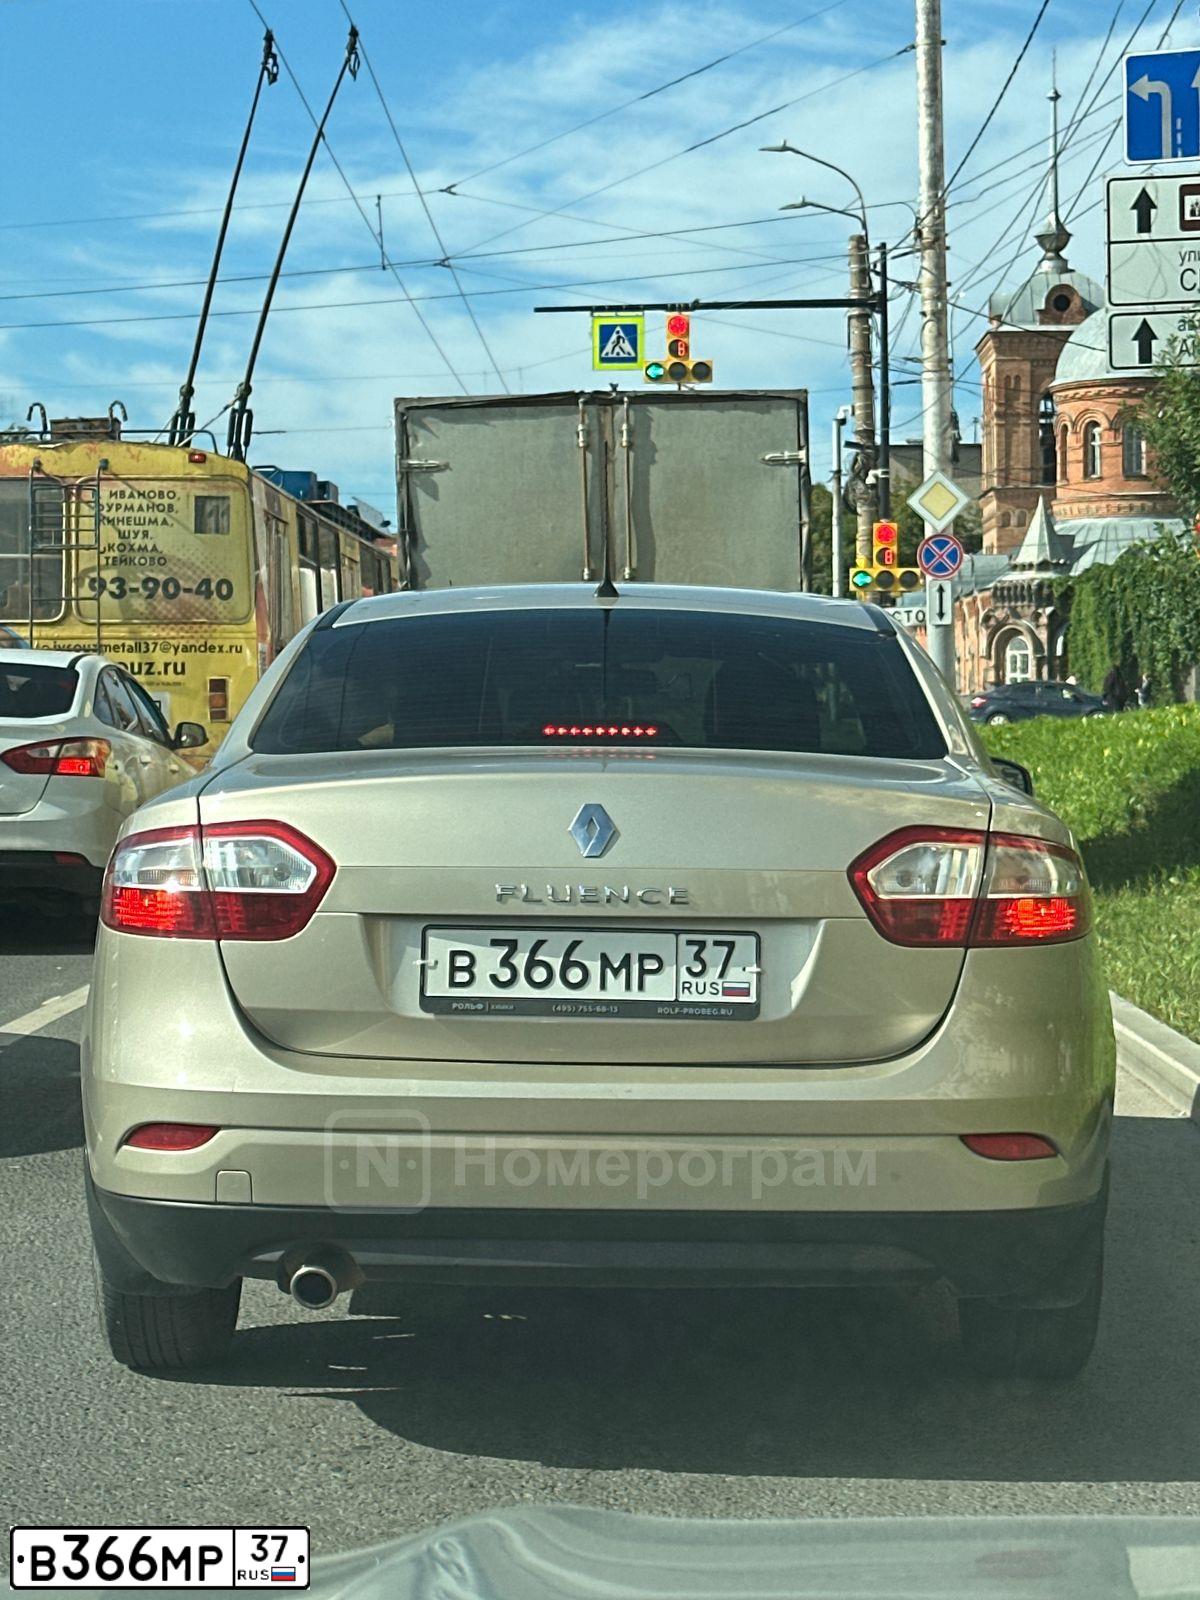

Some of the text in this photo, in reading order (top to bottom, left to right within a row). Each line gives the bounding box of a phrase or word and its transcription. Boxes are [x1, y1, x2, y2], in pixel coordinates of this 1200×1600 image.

[1180, 267, 1200, 293] С
[104, 556, 167, 567] ТЕЙКОВО
[88, 576, 234, 601] 93-90-40
[495, 884, 690, 905] FLUENCE
[449, 939, 736, 992] В366МР 37
[682, 982, 719, 996] RUS
[452, 1002, 483, 1010] РОЛЬФ
[657, 1007, 733, 1016] ROLF-PROBEG.RU
